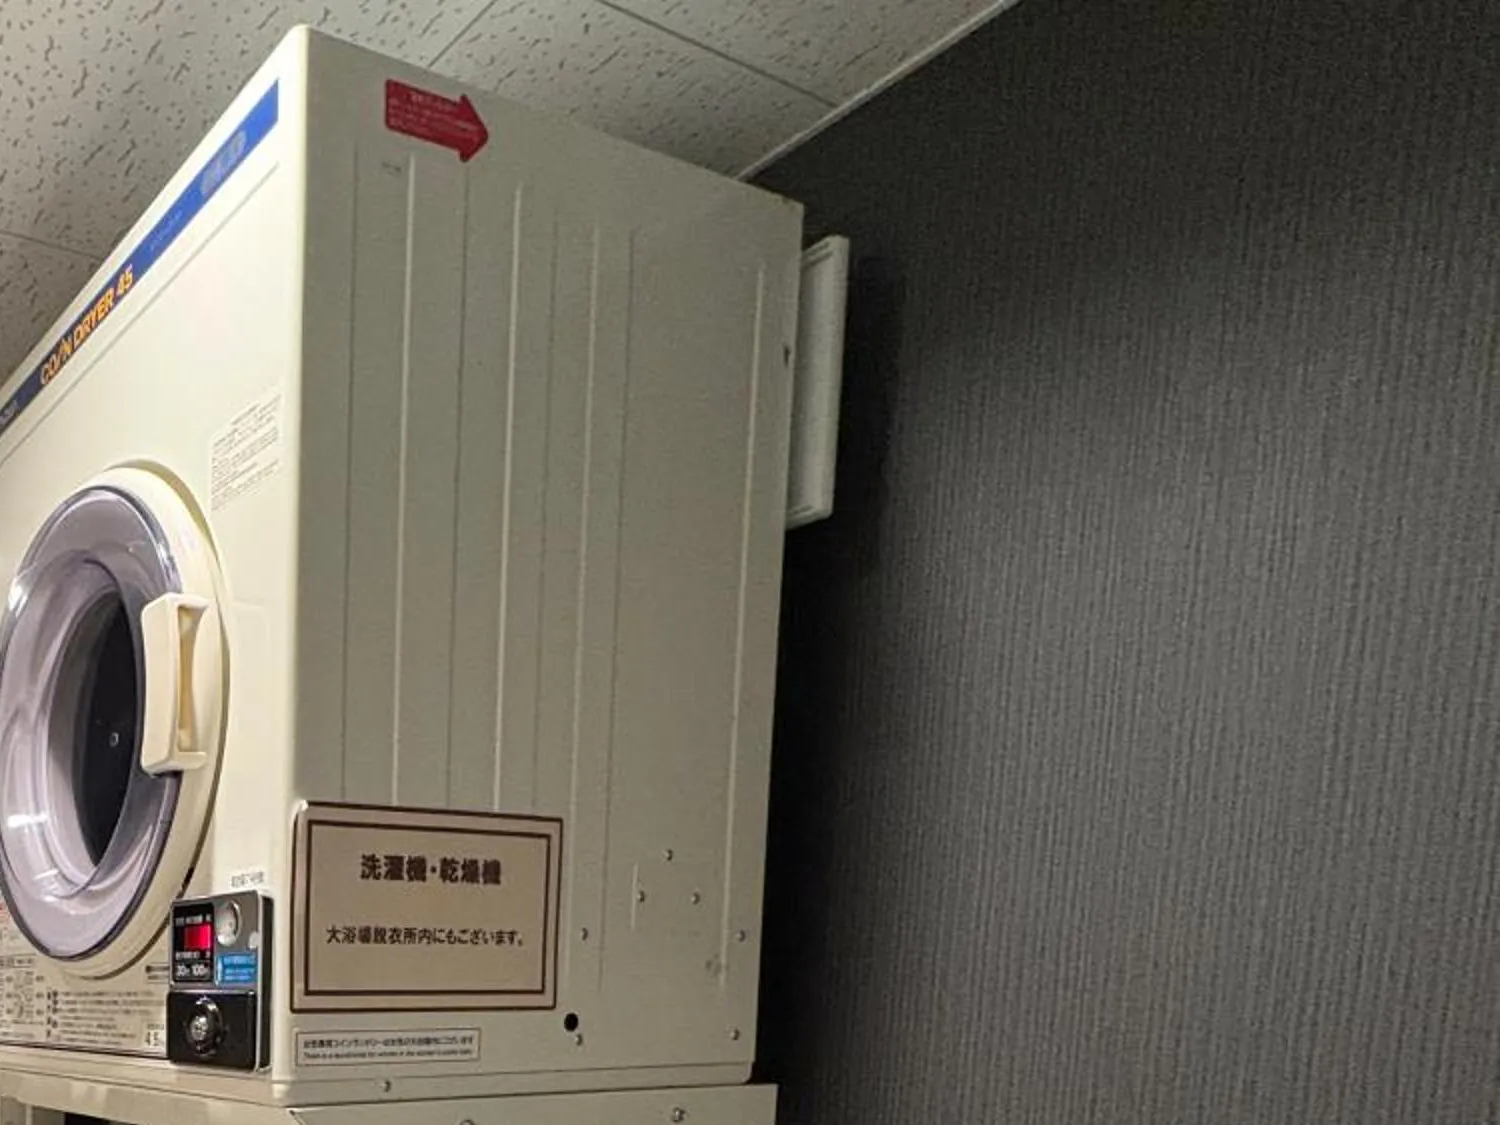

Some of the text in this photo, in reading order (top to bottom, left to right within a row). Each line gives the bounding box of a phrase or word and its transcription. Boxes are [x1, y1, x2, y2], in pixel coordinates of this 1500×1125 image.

[74, 287, 114, 349] DRYER
[116, 265, 134, 297] 45
[360, 854, 502, 885] 洗濯機・乾燥機
